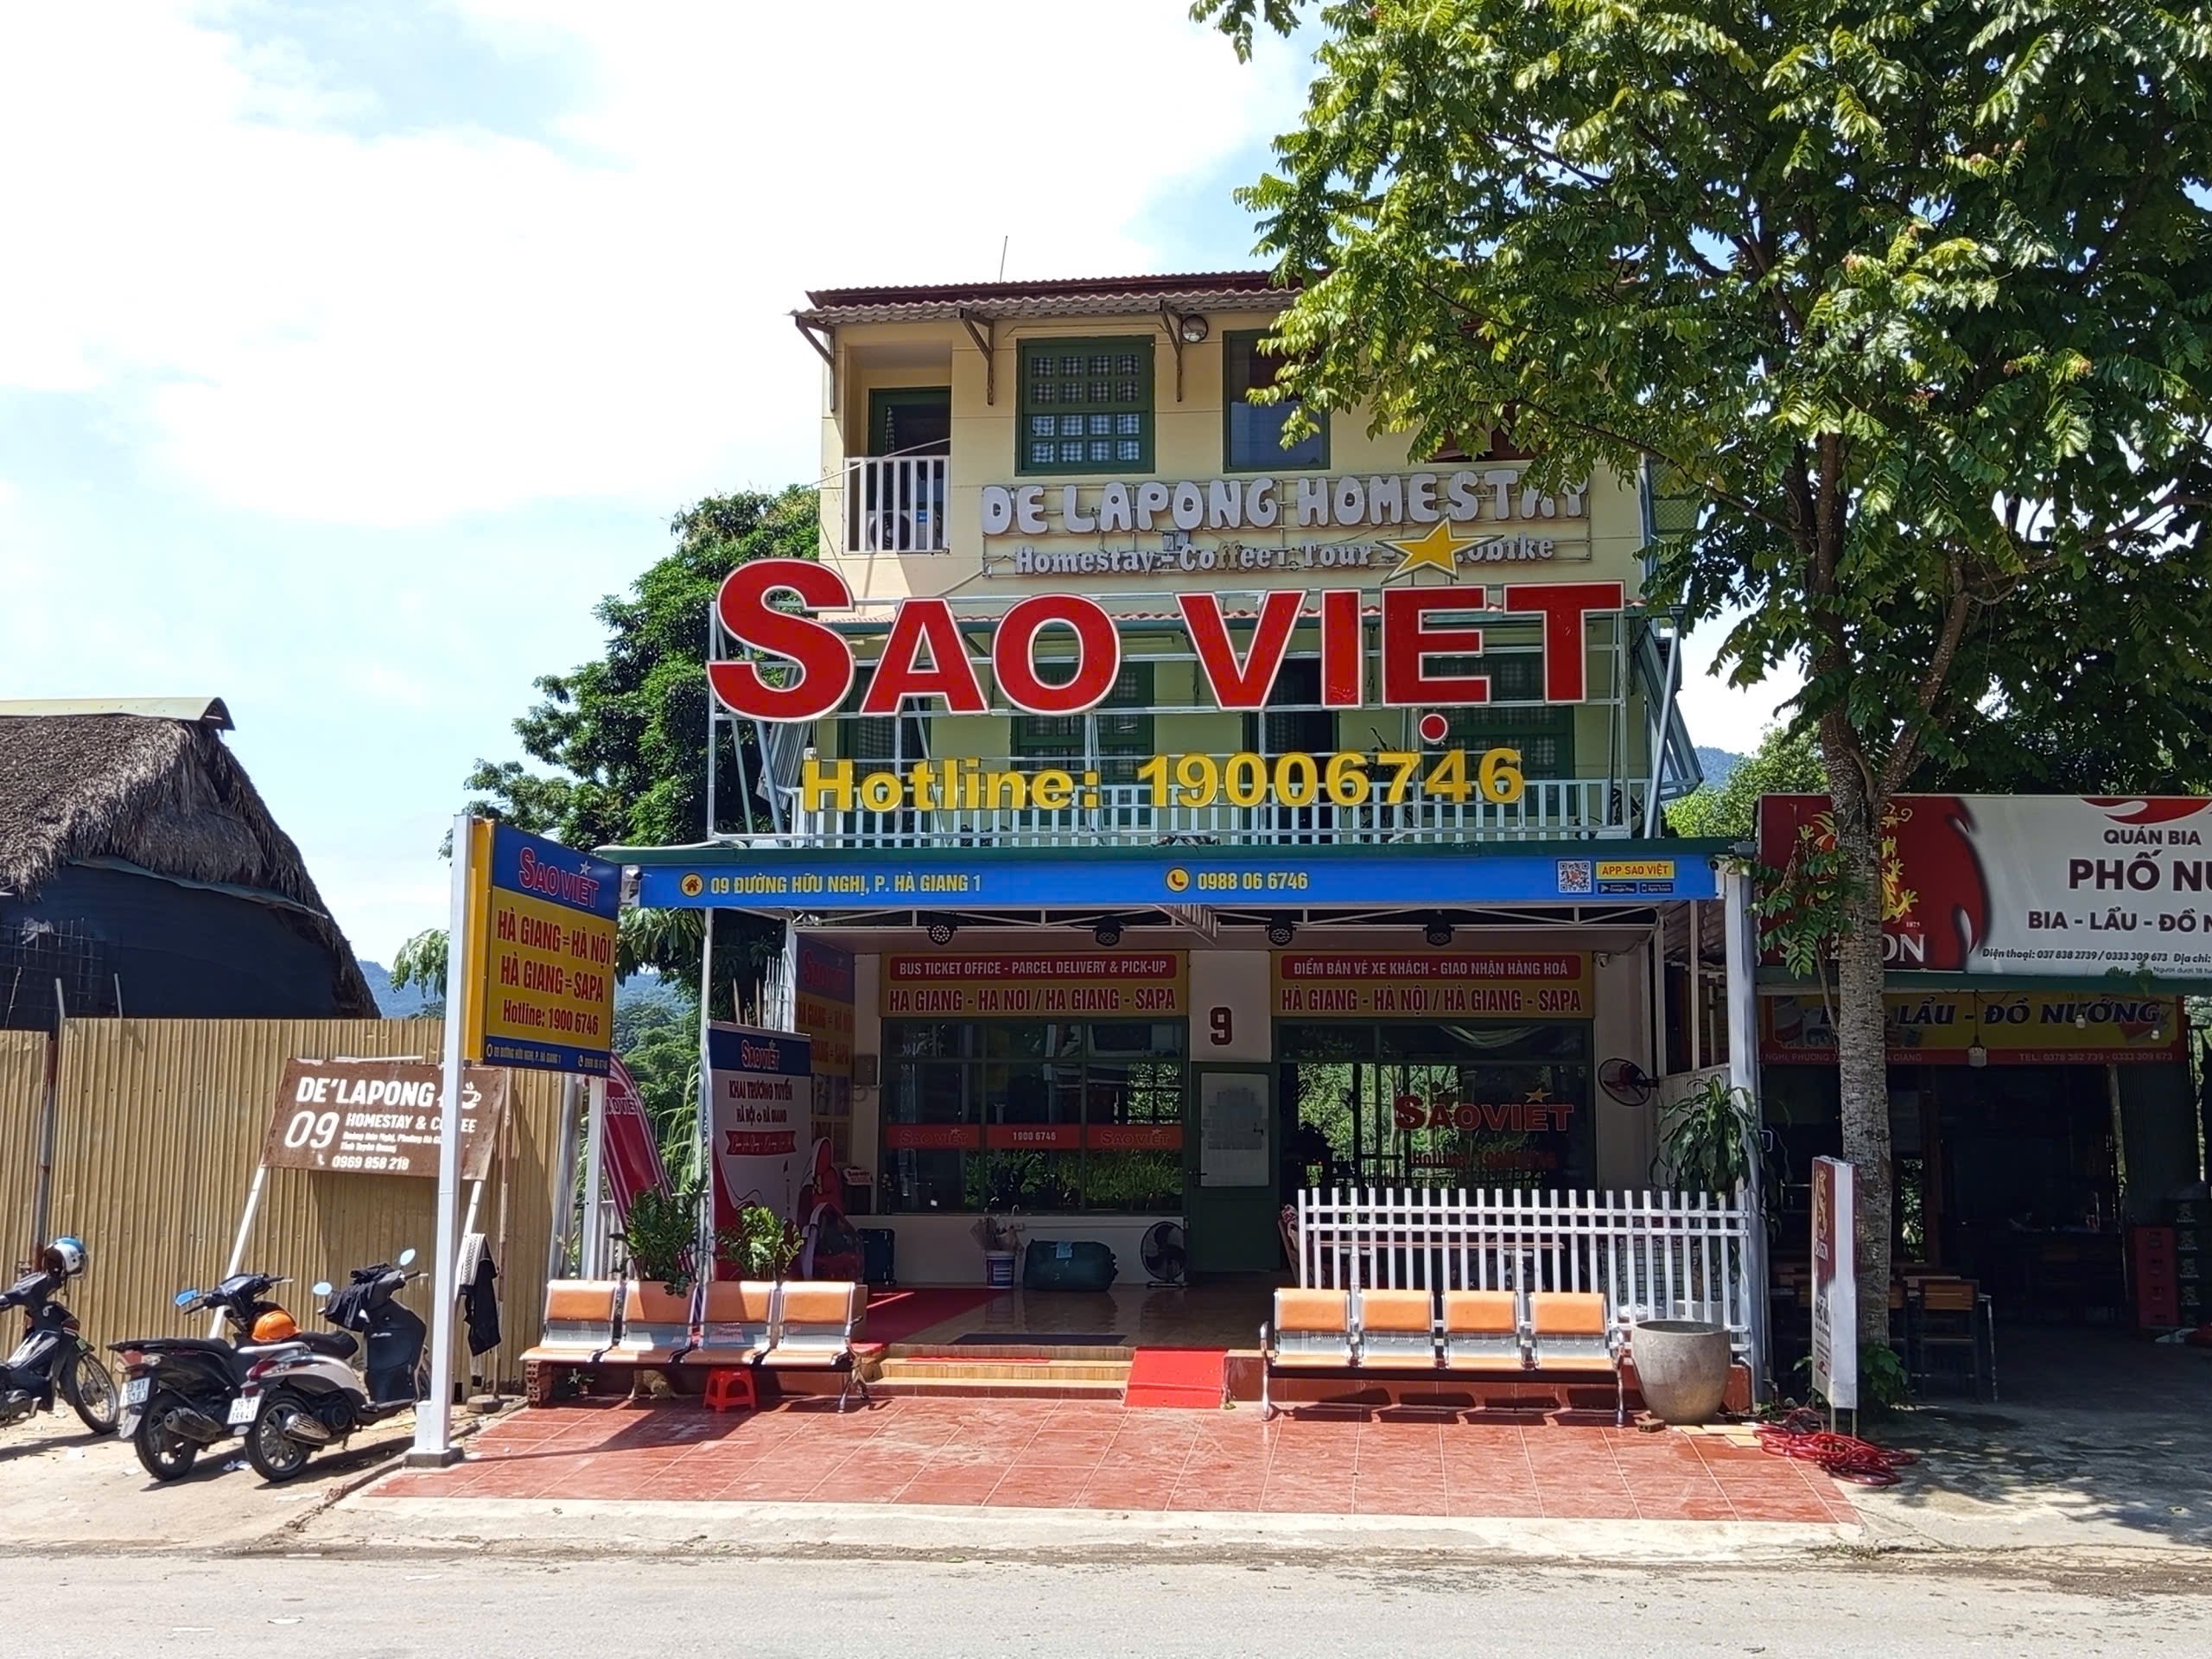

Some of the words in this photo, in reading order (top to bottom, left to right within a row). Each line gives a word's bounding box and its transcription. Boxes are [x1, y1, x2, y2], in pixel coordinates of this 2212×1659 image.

[982, 485, 1049, 534] DE
[1063, 478, 1277, 534] LAPONG
[1015, 546, 1154, 575] Homestay
[1179, 542, 1271, 572] Coffee
[1301, 542, 1371, 567] Tour
[1457, 532, 1554, 563] obike
[706, 557, 1121, 722] SAO
[803, 756, 1099, 812] Hotline:
[1137, 747, 1524, 810] 19006746
[2103, 826, 2162, 844] QUÁN
[2168, 830, 2202, 845] BIA
[1198, 873, 1237, 890] 0988
[1243, 873, 1262, 890] 06
[1267, 872, 1307, 890] 6746
[1601, 866, 1622, 874] APP
[1624, 866, 1644, 874] SAO
[1647, 863, 1669, 877] VIỆT
[2069, 849, 2162, 891] PHỐ
[710, 877, 730, 894] 09
[734, 873, 786, 894] ĐƯỜNG
[792, 873, 823, 893] HỮU
[828, 875, 869, 896] NGHỊ,
[874, 875, 889, 893] P.
[894, 872, 915, 893] HÀ
[919, 874, 968, 892] GIANG
[972, 874, 981, 891] 1
[2028, 911, 2069, 930] BIA
[2089, 906, 2137, 931] LẨU
[2158, 907, 2196, 932] ĐỒ
[497, 907, 516, 942] HÀ
[521, 917, 561, 952] GIANG
[571, 926, 587, 959] HÀ
[590, 932, 611, 969] NỘI
[899, 963, 921, 976] BUS
[925, 962, 963, 976] TICKET
[964, 961, 1001, 975] OFFICE
[1012, 961, 1054, 975] PARCEL
[1056, 960, 1106, 974] DELIVERY
[1109, 960, 1118, 974] &
[1122, 960, 1166, 974] PICK-UP
[1294, 957, 1325, 976] ĐIỂM
[1326, 958, 1351, 976] BÁN
[1354, 958, 1369, 975] VÉ
[1371, 962, 1387, 975] XE
[1389, 958, 1429, 975] KHÁCH
[1440, 962, 1467, 975] GIAO
[1471, 959, 1505, 977] NHẬN
[1508, 958, 1540, 975] HÀNG
[1544, 958, 1568, 975] HOÁ
[2006, 949, 2036, 961] thoại:
[2037, 950, 2055, 959] 037
[2056, 950, 2073, 959] 838
[2075, 950, 2097, 960] 2739
[2106, 951, 2129, 961] 0333
[2131, 952, 2149, 962] 309
[2151, 952, 2168, 962] 673
[500, 951, 519, 986] HÀ
[524, 960, 563, 995] GIANG
[574, 971, 604, 1002] SAPA
[889, 989, 910, 1011] HA
[915, 989, 963, 1011] GIANG
[978, 989, 1000, 1011] HA
[1003, 988, 1031, 1011] NOI
[1046, 988, 1066, 1010] HA
[1071, 988, 1119, 1010] GIANG
[1135, 988, 1176, 1010] SAPA
[1282, 984, 1303, 1011] HÀ
[1308, 988, 1357, 1011] GIANG
[1374, 984, 1396, 1011] HÀ
[1400, 984, 1428, 1014] NỘI
[1444, 984, 1466, 1011] HÀ
[1471, 988, 1522, 1011] GIANG
[1538, 988, 1582, 1011] SAPA
[1898, 996, 1956, 1025] LẨU
[1984, 997, 2031, 1025] ĐỒ
[504, 999, 545, 1027] Hotline:
[549, 1007, 572, 1032] 1900
[575, 1013, 599, 1035] 6746
[1210, 1007, 1232, 1045] 9
[284, 1110, 340, 1148] 09
[346, 1112, 413, 1129] HOMESTAY
[415, 1116, 426, 1130] &
[1012, 1131, 1033, 1141] 1900
[1034, 1131, 1057, 1141] 6746
[332, 1155, 361, 1169] 0969
[364, 1155, 386, 1170] 858
[388, 1155, 410, 1170] 218
